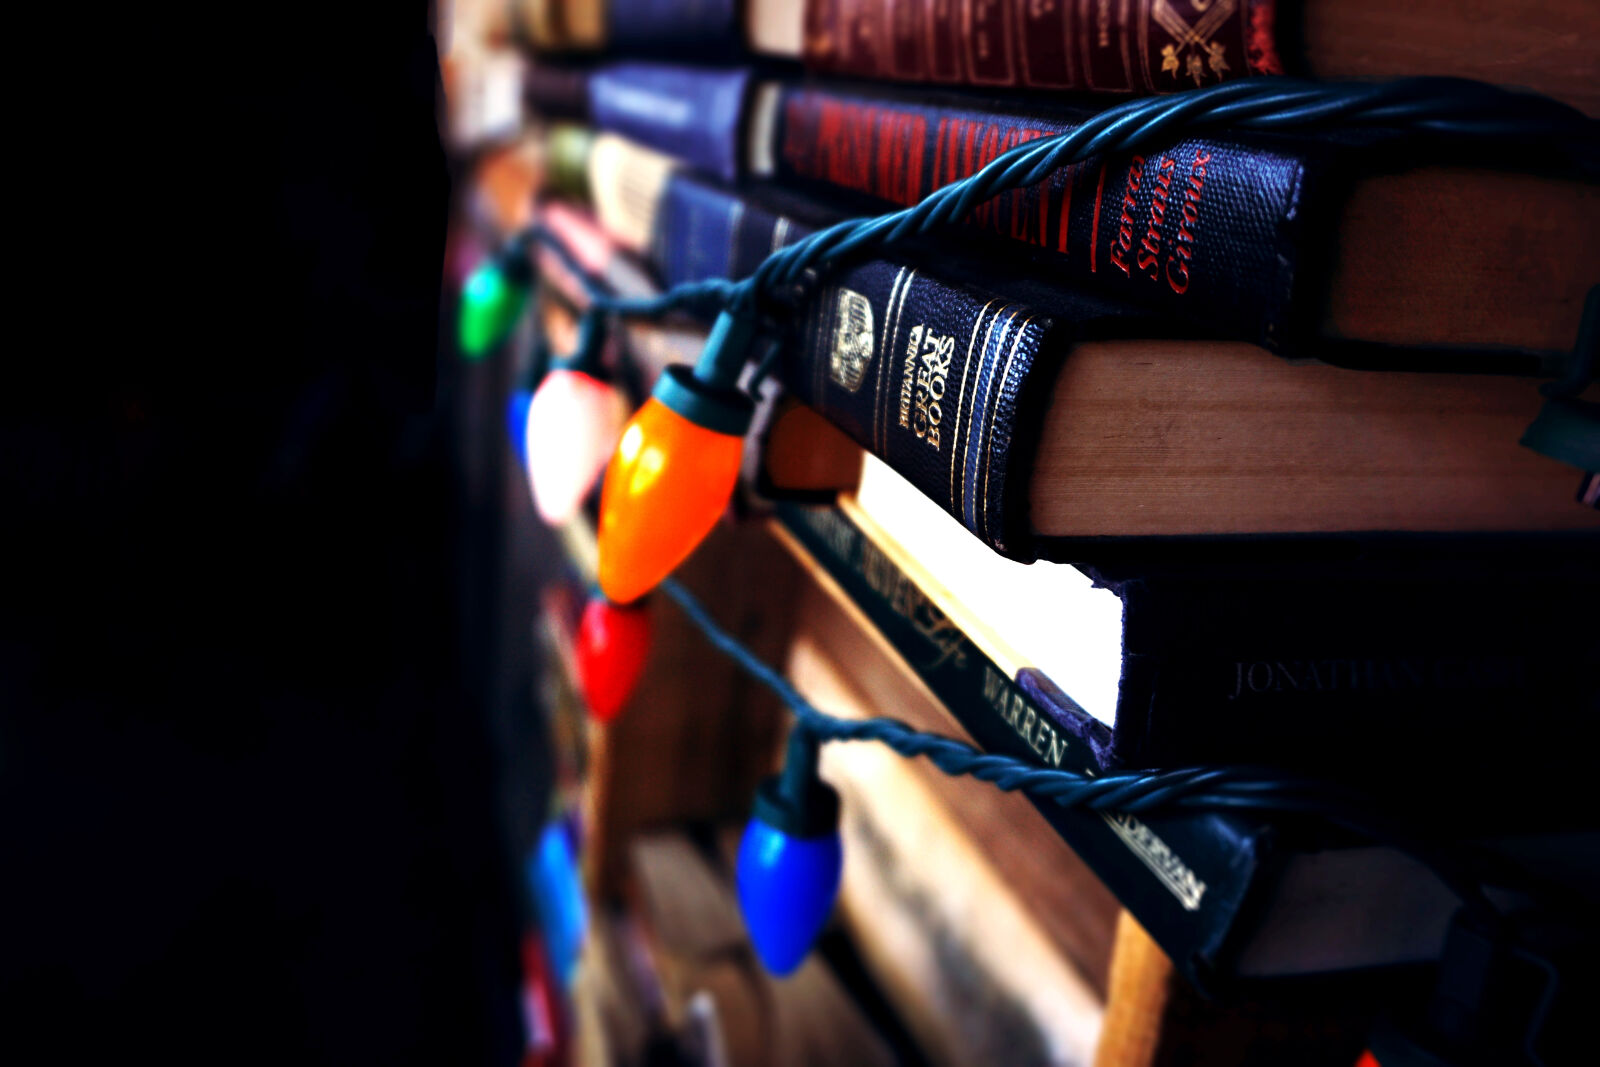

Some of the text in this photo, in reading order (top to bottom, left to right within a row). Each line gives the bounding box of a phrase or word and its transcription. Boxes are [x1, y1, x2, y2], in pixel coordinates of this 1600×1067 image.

[1110, 155, 1145, 278] Farrar
[1137, 156, 1174, 281] Straus
[1166, 149, 1211, 294] Giroux
[900, 323, 924, 429] BRITANNICA
[913, 327, 942, 439] GREAT
[926, 336, 955, 451] BOOKS
[984, 666, 1068, 768] WARREN
